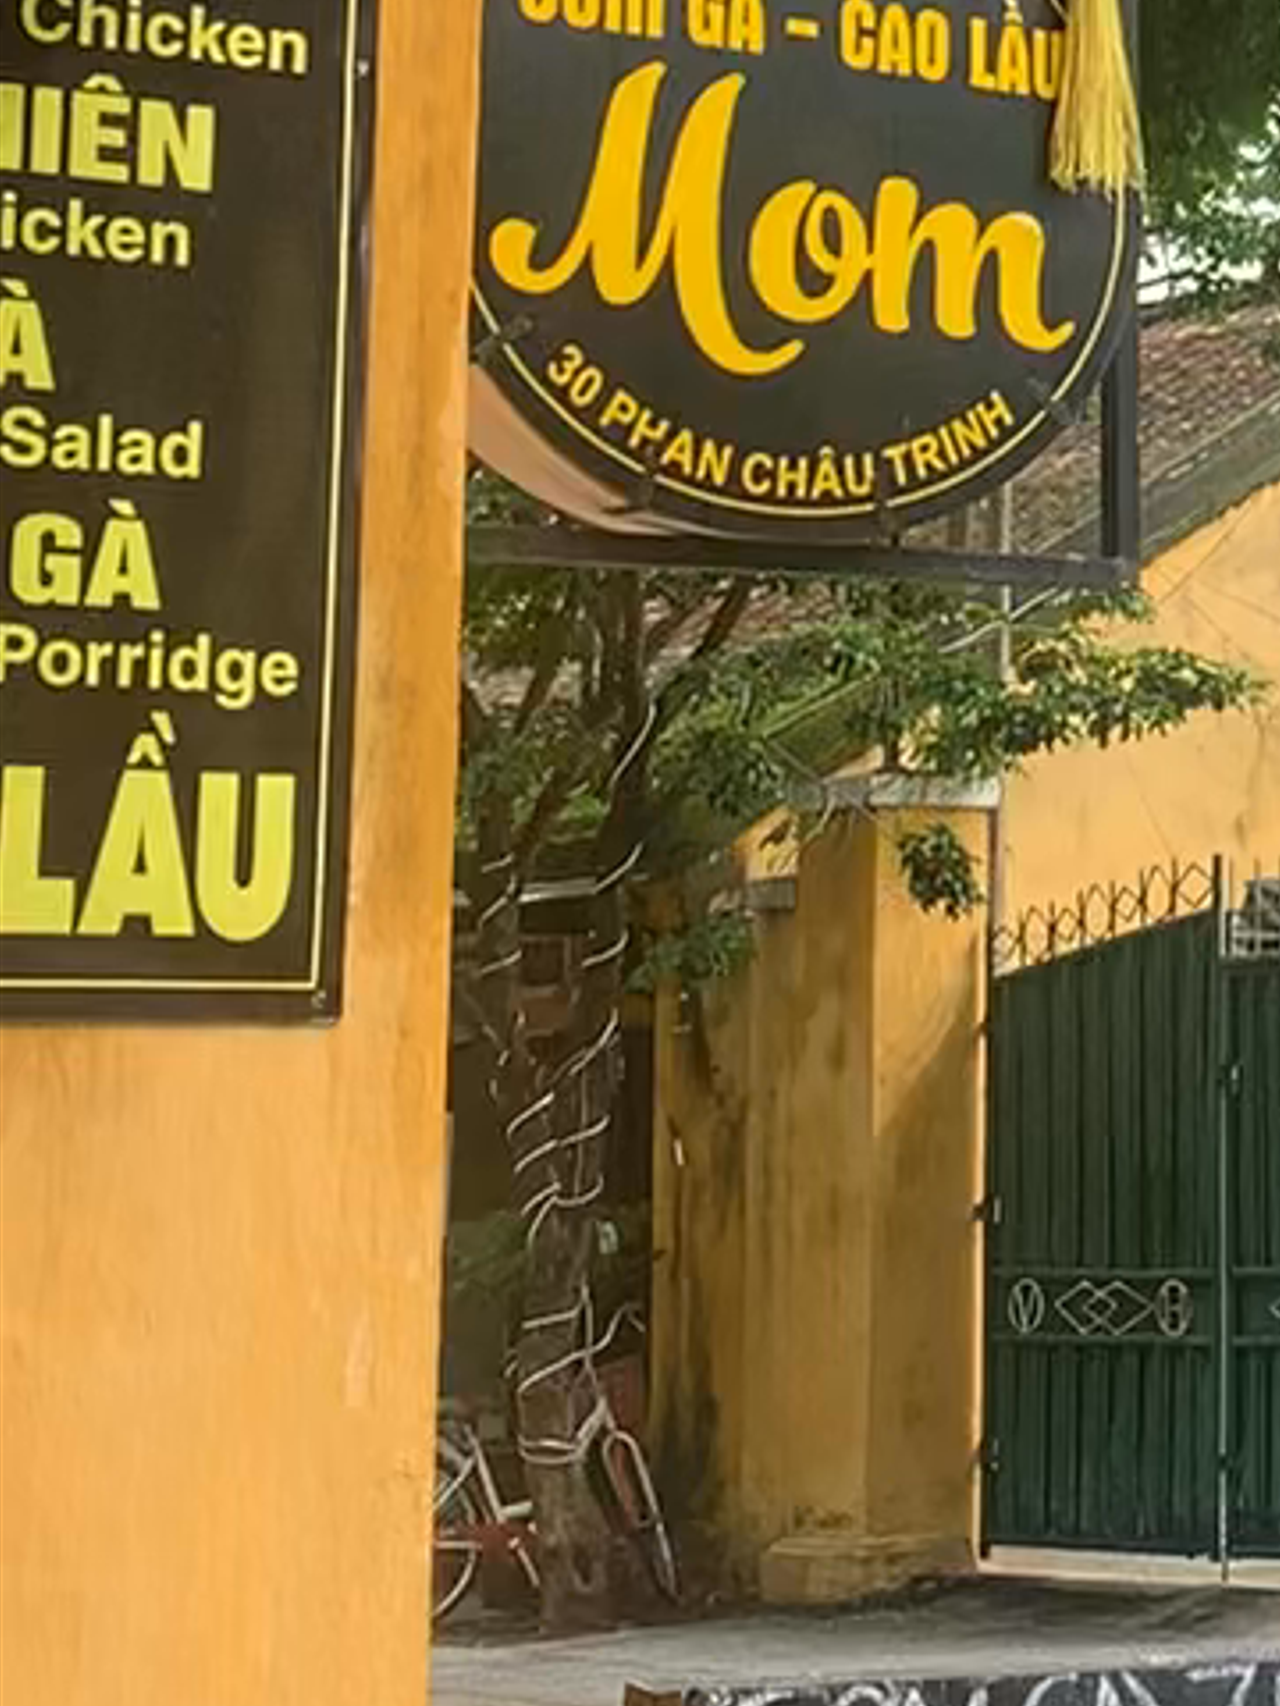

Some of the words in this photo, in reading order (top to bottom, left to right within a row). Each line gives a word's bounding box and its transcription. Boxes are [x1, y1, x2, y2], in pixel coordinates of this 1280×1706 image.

[0, 190, 191, 267] icken
[489, 60, 1076, 375] Mom
[0, 405, 204, 480] Salad
[547, 343, 604, 408] 30
[599, 390, 733, 487] PHAN
[741, 445, 874, 502] CHÂU
[881, 390, 1015, 488] TRINH
[10, 498, 162, 612] GÀ
[0, 622, 299, 710] Porridge
[0, 710, 297, 943] LẦU
